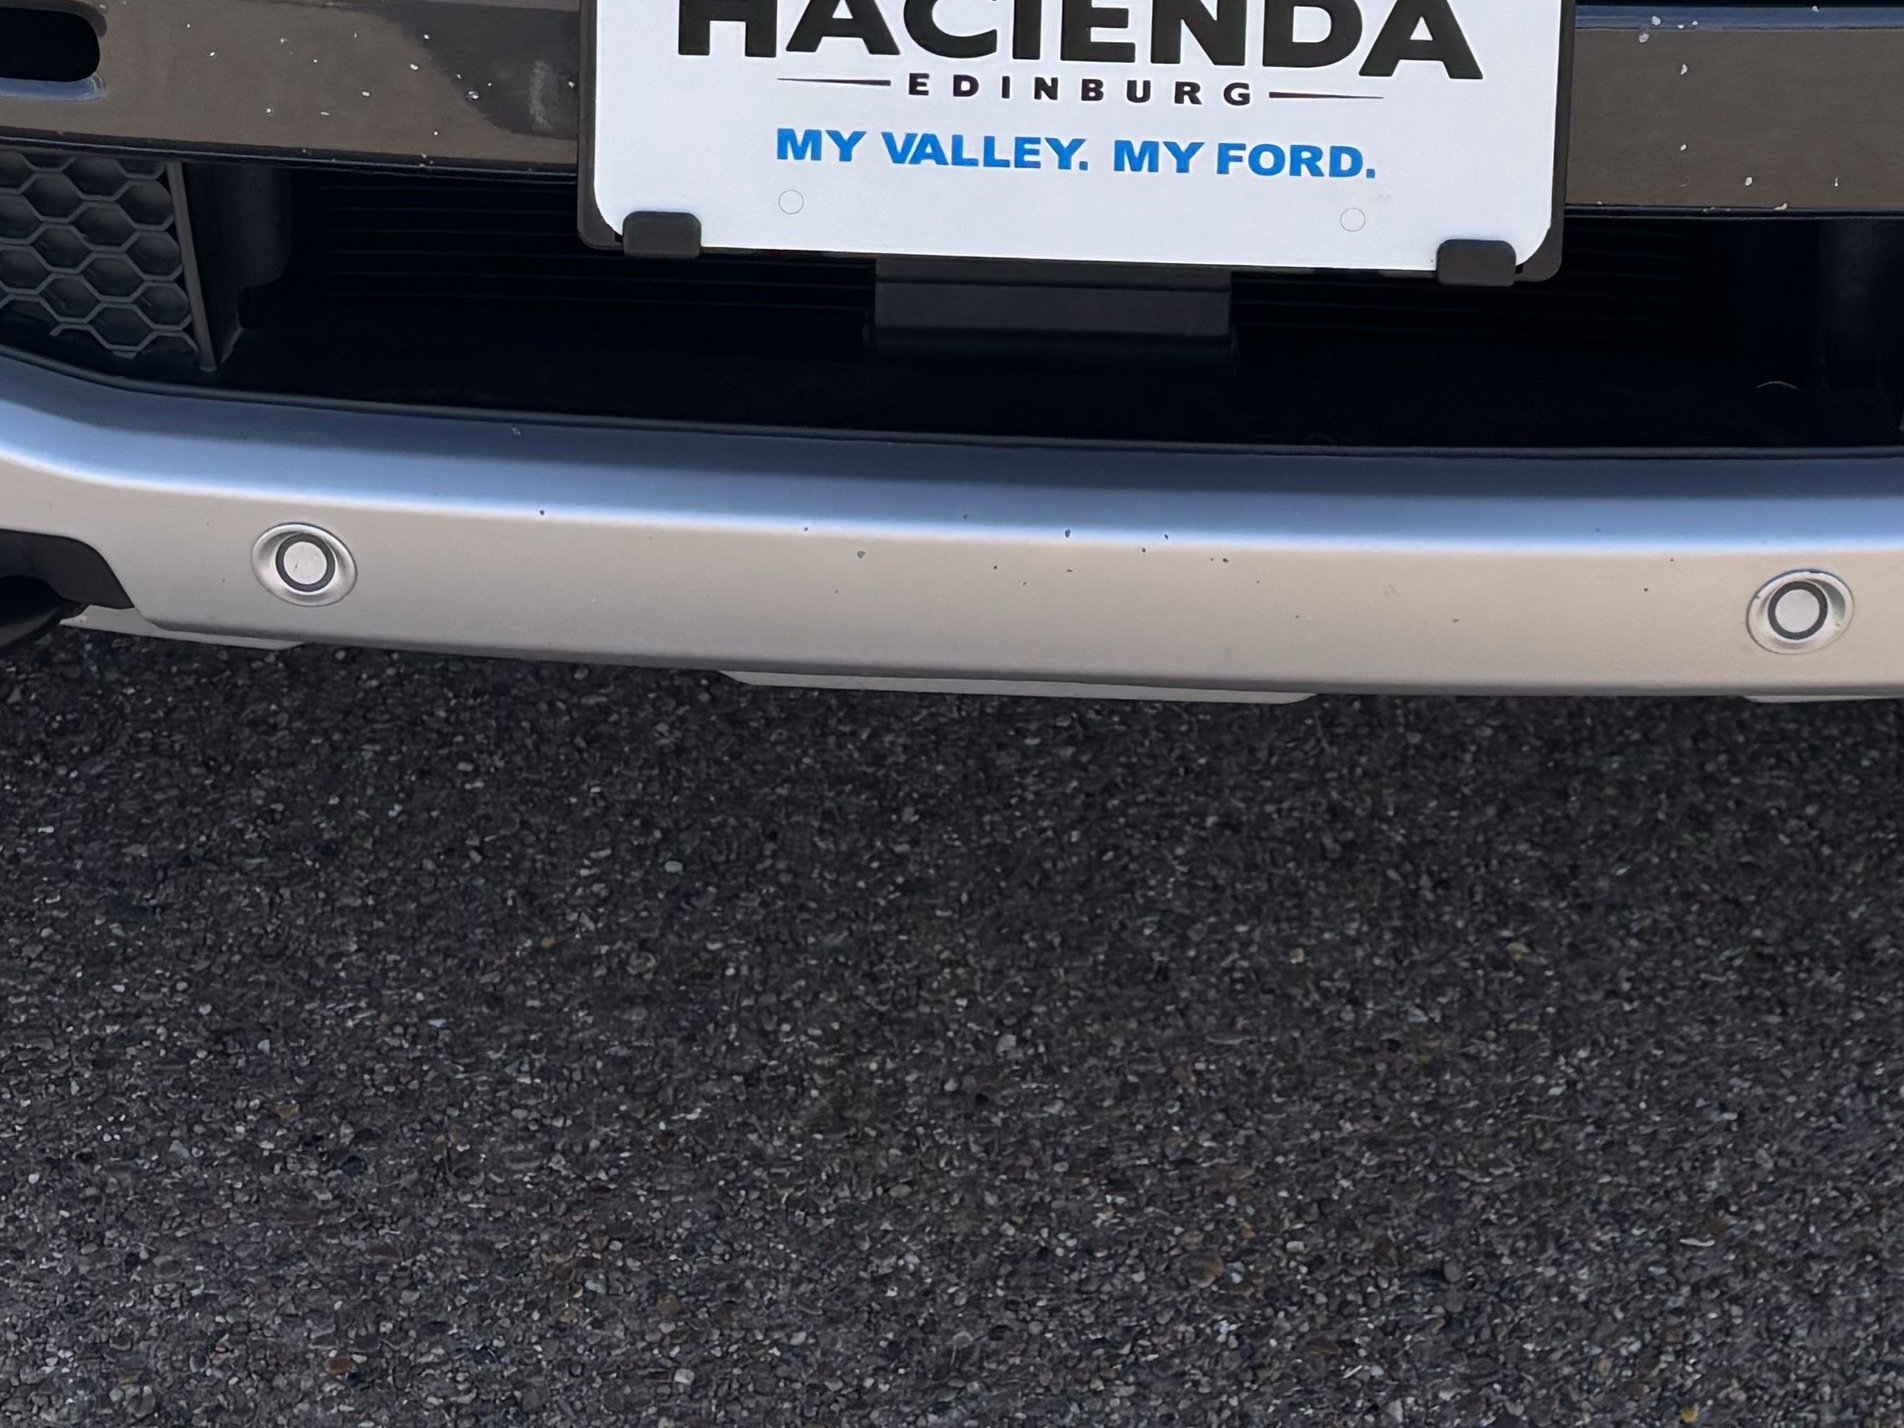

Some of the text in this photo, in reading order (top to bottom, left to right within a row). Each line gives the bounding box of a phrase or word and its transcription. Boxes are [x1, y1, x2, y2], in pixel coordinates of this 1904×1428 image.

[907, 72, 1252, 107] EDINBURG
[775, 128, 1376, 179] MY VALLEY. MY FORD.
